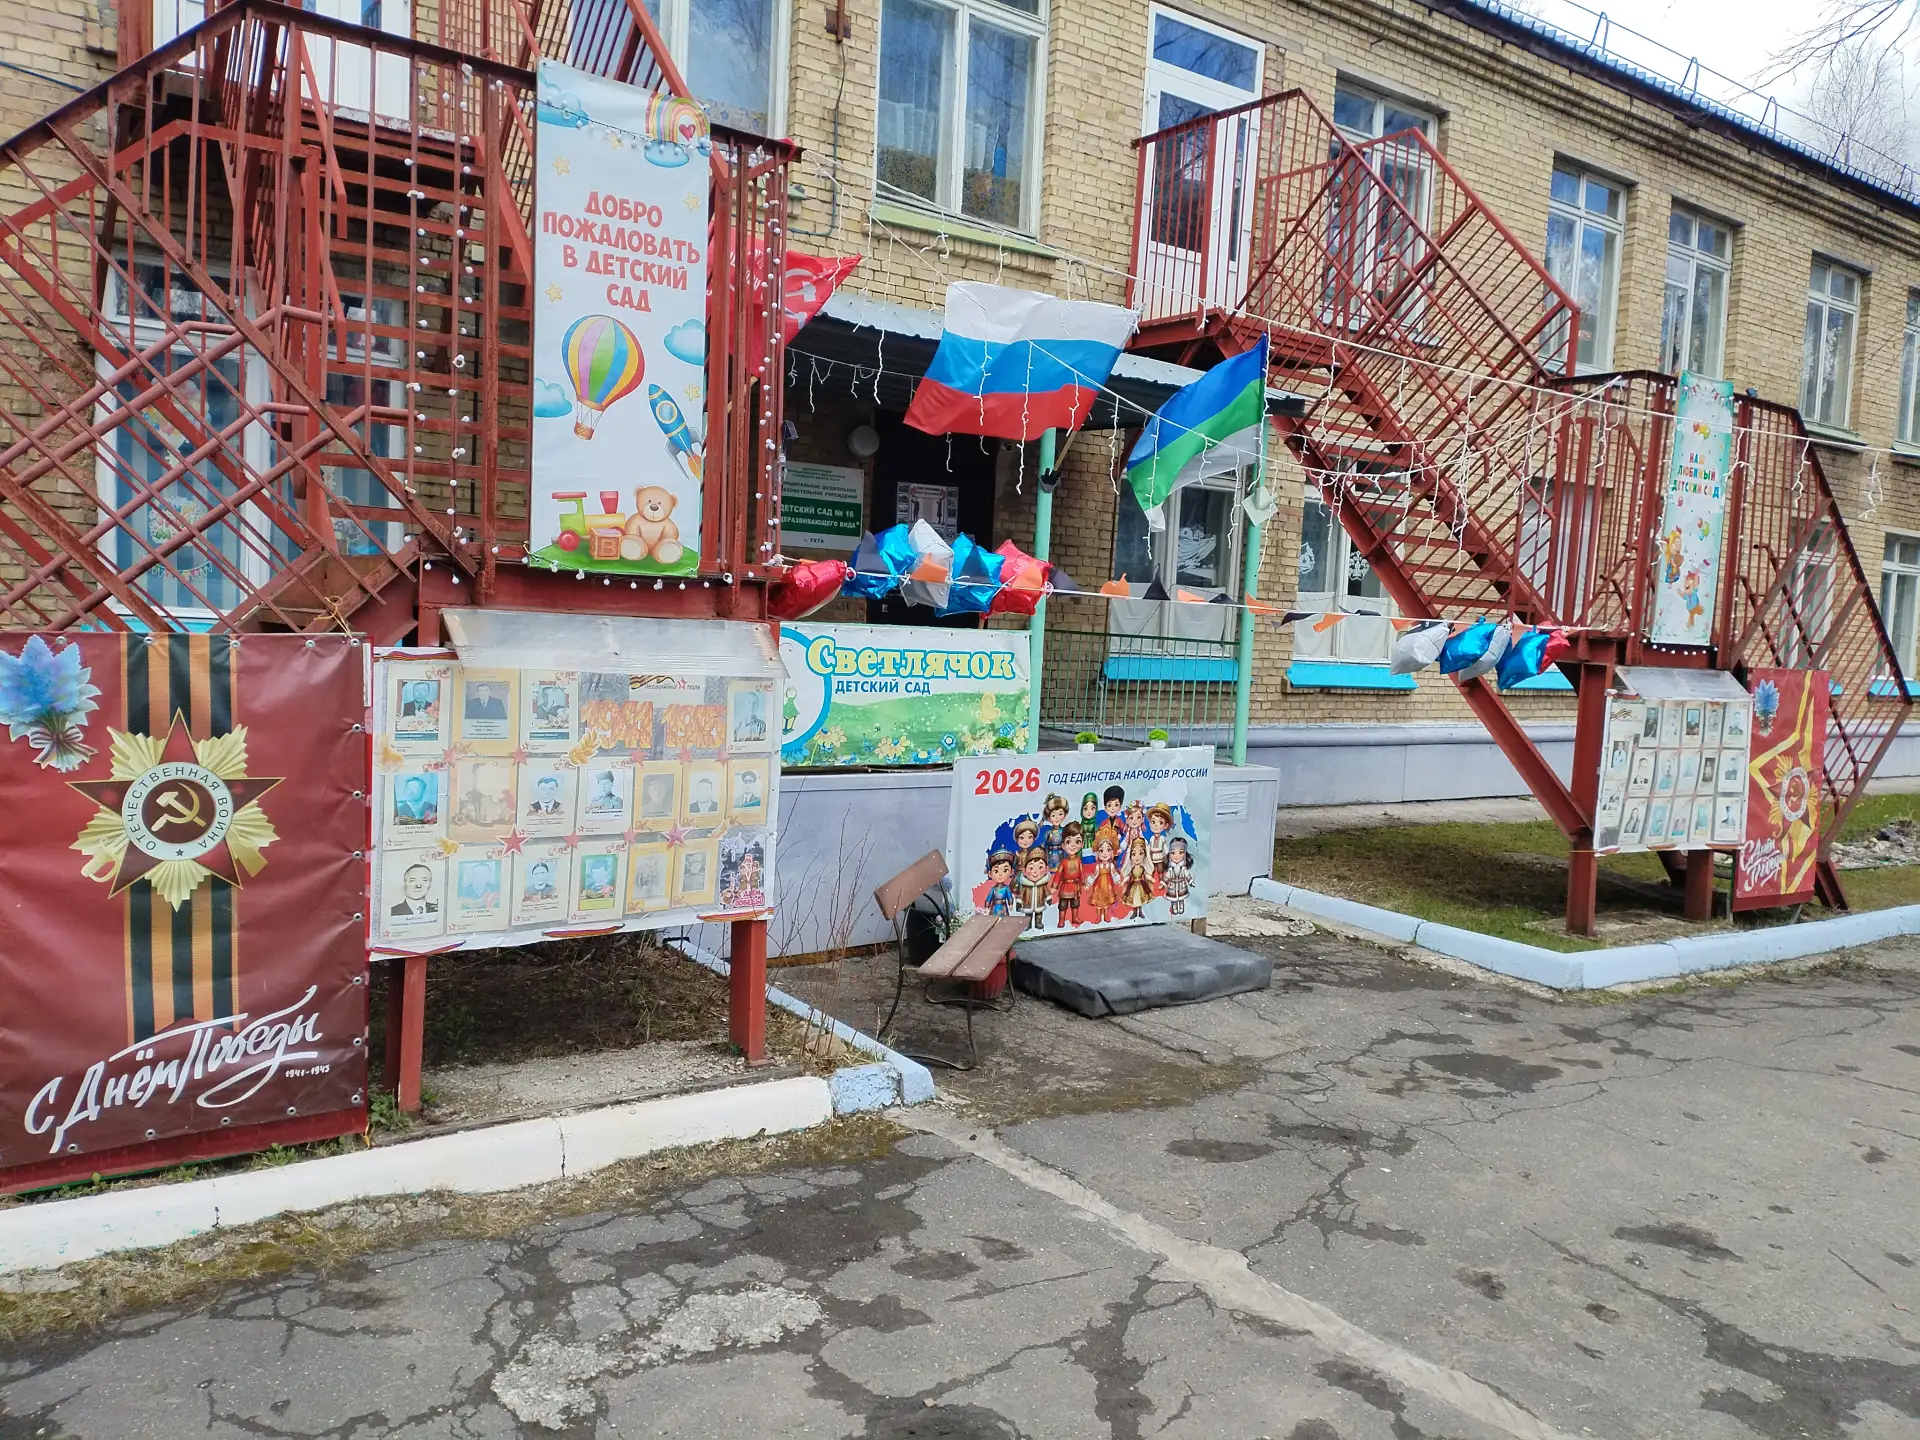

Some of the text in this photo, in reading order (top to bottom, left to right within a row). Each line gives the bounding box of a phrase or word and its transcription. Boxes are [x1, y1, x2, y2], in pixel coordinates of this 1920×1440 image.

[584, 190, 663, 228] ДОБРО
[543, 211, 701, 264] ПОЖАЛОВАТЬ
[563, 244, 688, 291] В ДЕТСКИЙ
[606, 282, 652, 313] САД
[817, 507, 833, 517] САД
[806, 635, 1016, 681] Светлячок
[835, 678, 931, 696] ДЕТСКИЙ САД
[974, 767, 1208, 796] 2026 ГОД ЕДИНСТВА НАРОДОВ РОССИИ
[127, 766, 220, 851] ОТЕЧЕСТВЕННАЯ
[285, 1064, 330, 1078] 1941-1945
[24, 1077, 62, 1135] С
